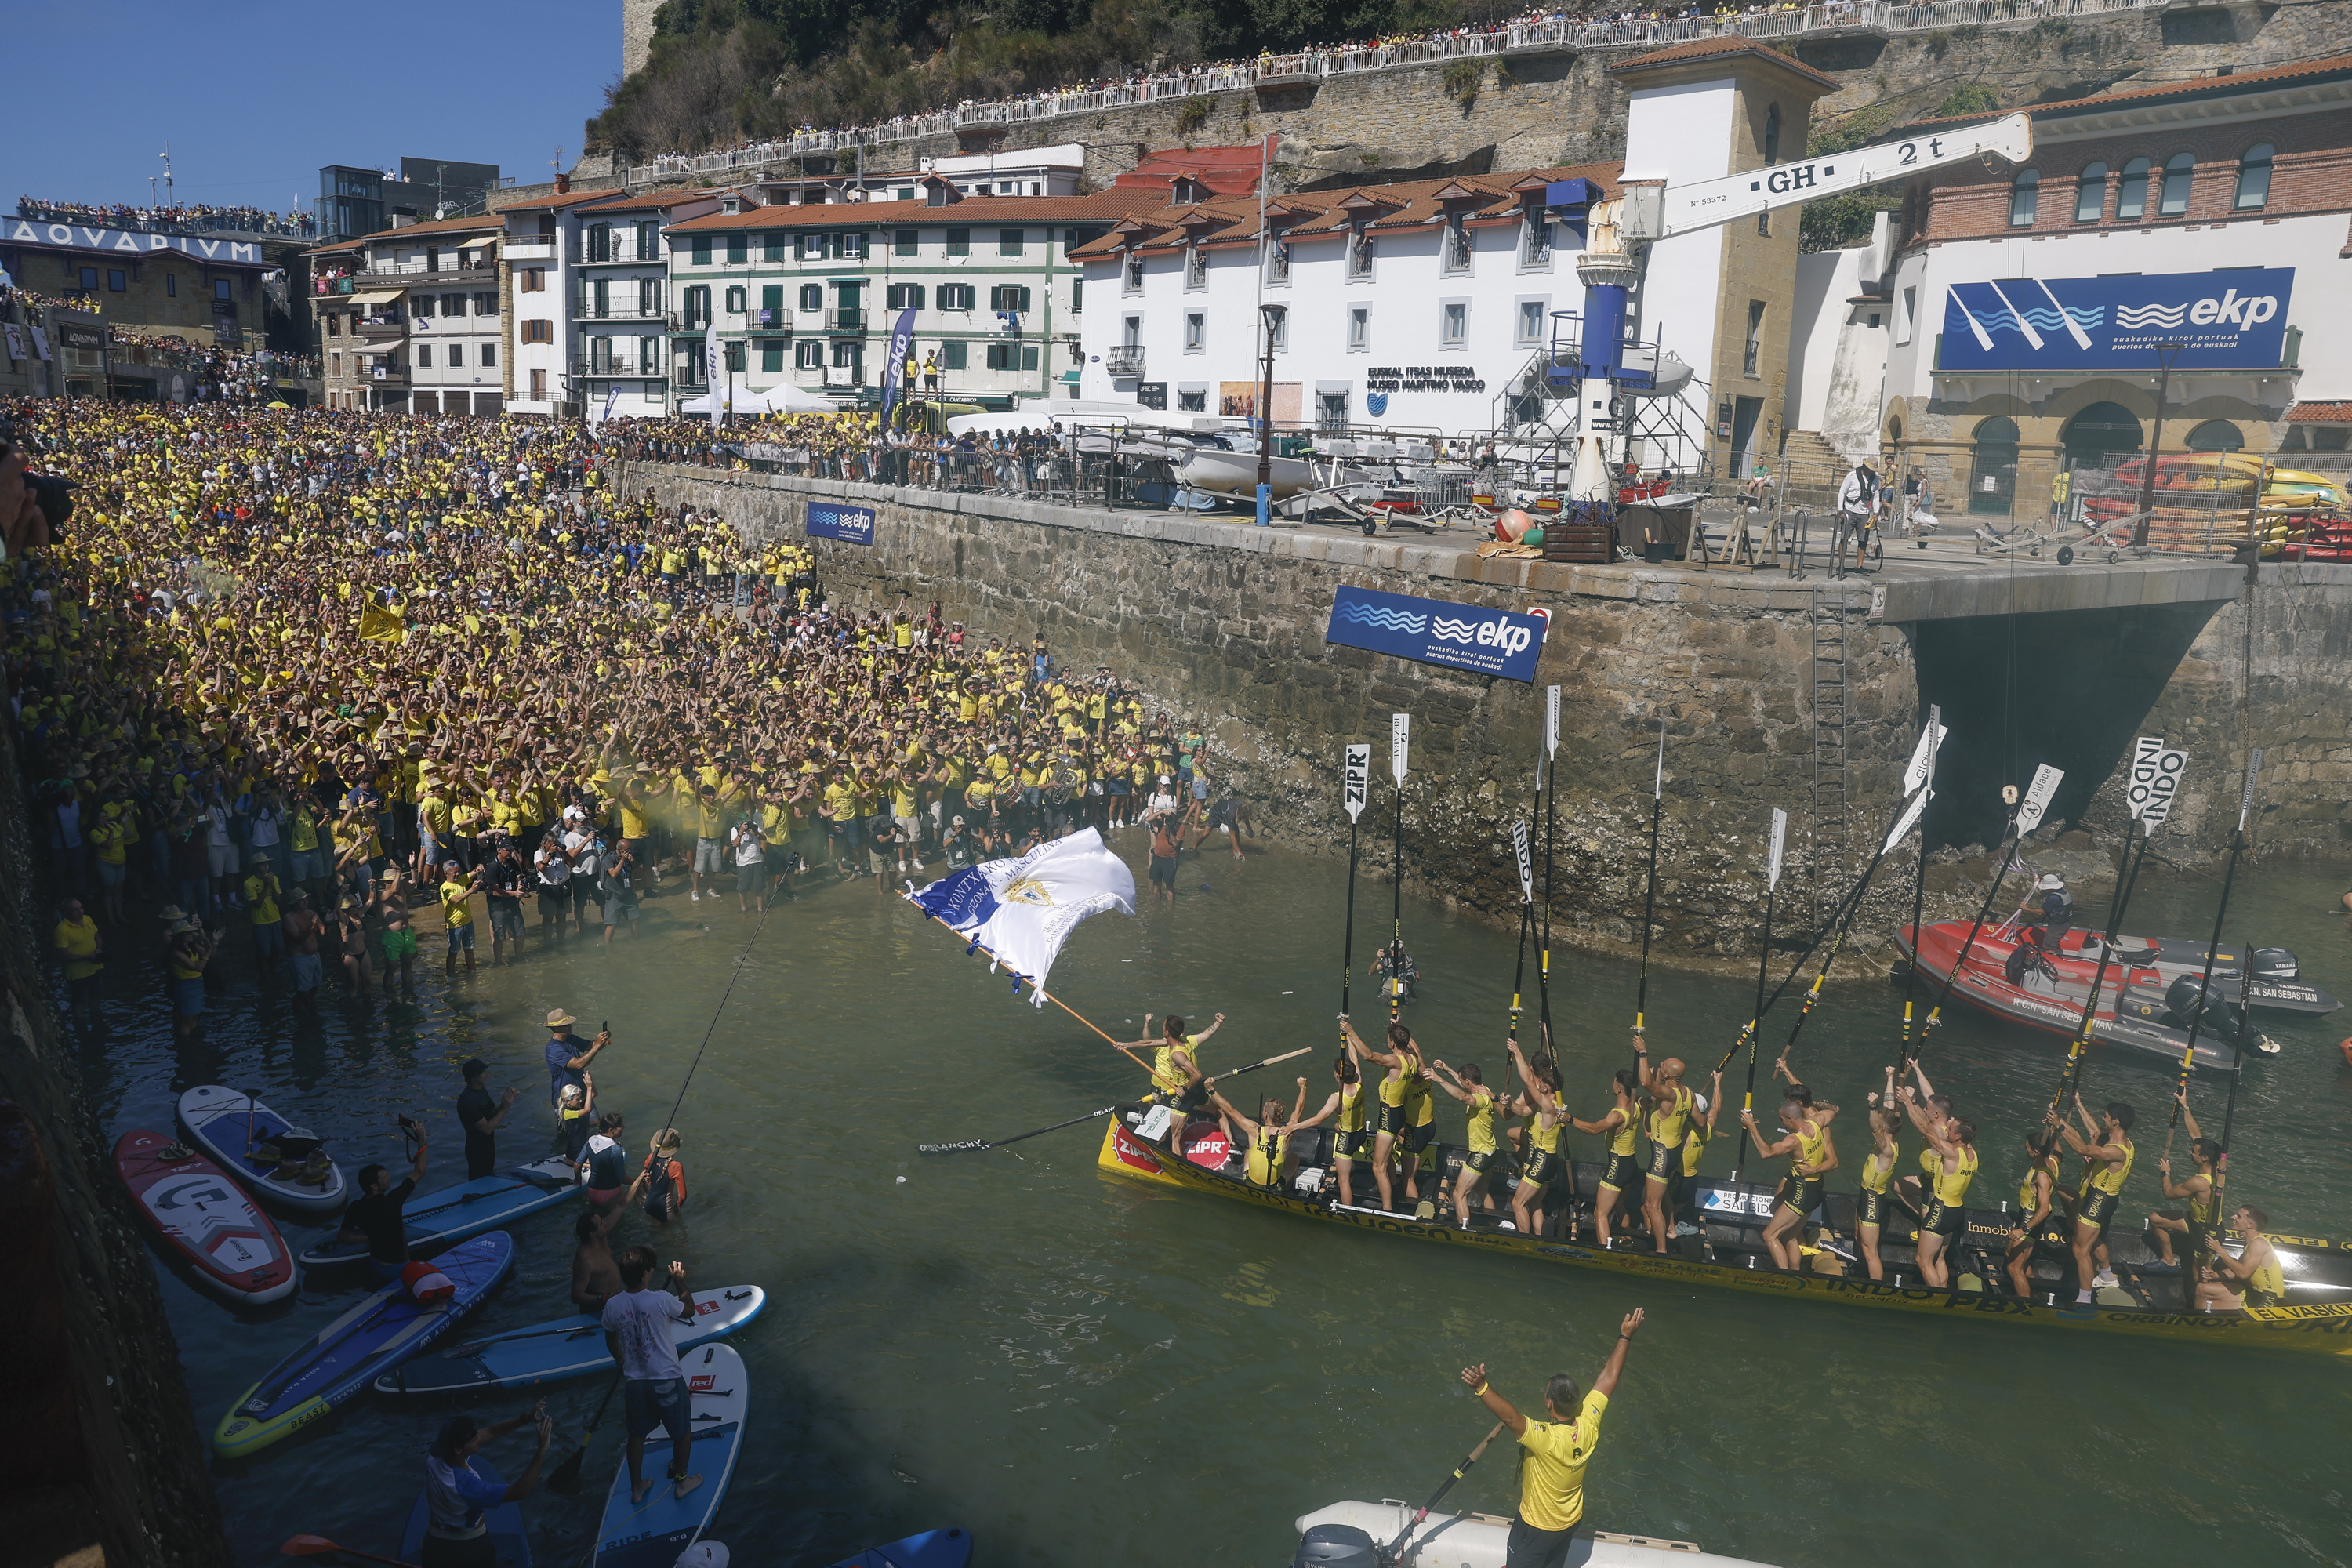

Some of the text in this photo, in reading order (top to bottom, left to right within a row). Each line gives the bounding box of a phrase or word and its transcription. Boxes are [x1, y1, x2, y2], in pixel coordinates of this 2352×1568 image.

[1898, 137, 1944, 166] 2 t
[1768, 164, 1817, 194] GH
[1702, 195, 1726, 205] 53372
[2190, 289, 2278, 331] ekp
[2198, 333, 2240, 343] portuak
[709, 346, 717, 380] ekp
[890, 334, 907, 376] ekp
[1368, 367, 1475, 376] EUSKAL ITSAS MUSEOA
[1367, 379, 1399, 390] MUSEO
[1452, 379, 1486, 390] VASCO
[853, 510, 870, 533] ekp
[1476, 616, 1531, 657] ekp
[1425, 651, 1445, 660] puertos
[1446, 655, 1472, 665] deportivos
[1481, 661, 1503, 670] euskadi
[1428, 644, 1459, 655] euskadiko
[1478, 653, 1505, 663] portuak
[2032, 768, 2051, 797] Aldape
[2129, 739, 2161, 804] INDO
[2143, 753, 2183, 821] INDO
[1515, 822, 1530, 882] INDO
[948, 860, 1007, 911] KONTXAKO
[967, 880, 1000, 916] GIZONAK
[1004, 837, 1063, 881] MASCULINA
[2263, 986, 2277, 998] SAN
[2278, 989, 2318, 1003] SEBASTIAN
[2013, 997, 2039, 1013] R.C.N.
[2042, 1004, 2060, 1018] SAN
[1530, 1152, 1544, 1177] ORIALKI
[1654, 1146, 1664, 1172] ORIALKI
[1176, 1161, 1290, 1207] SAGARDI
[1723, 1200, 1772, 1214] SALBID
[1867, 1193, 1876, 1220] ORIALKI
[2088, 1192, 2104, 1218] ORIALKI
[1642, 1260, 1721, 1275] SETALDE
[1827, 1279, 1933, 1299] INDO
[1944, 1294, 2034, 1316] PBX
[2256, 1308, 2285, 1320] EL
[2107, 1312, 2243, 1328] ORBINOX
[691, 1375, 712, 1388] red
[290, 1403, 325, 1429] BEAST
[605, 1530, 652, 1552] RIDE
